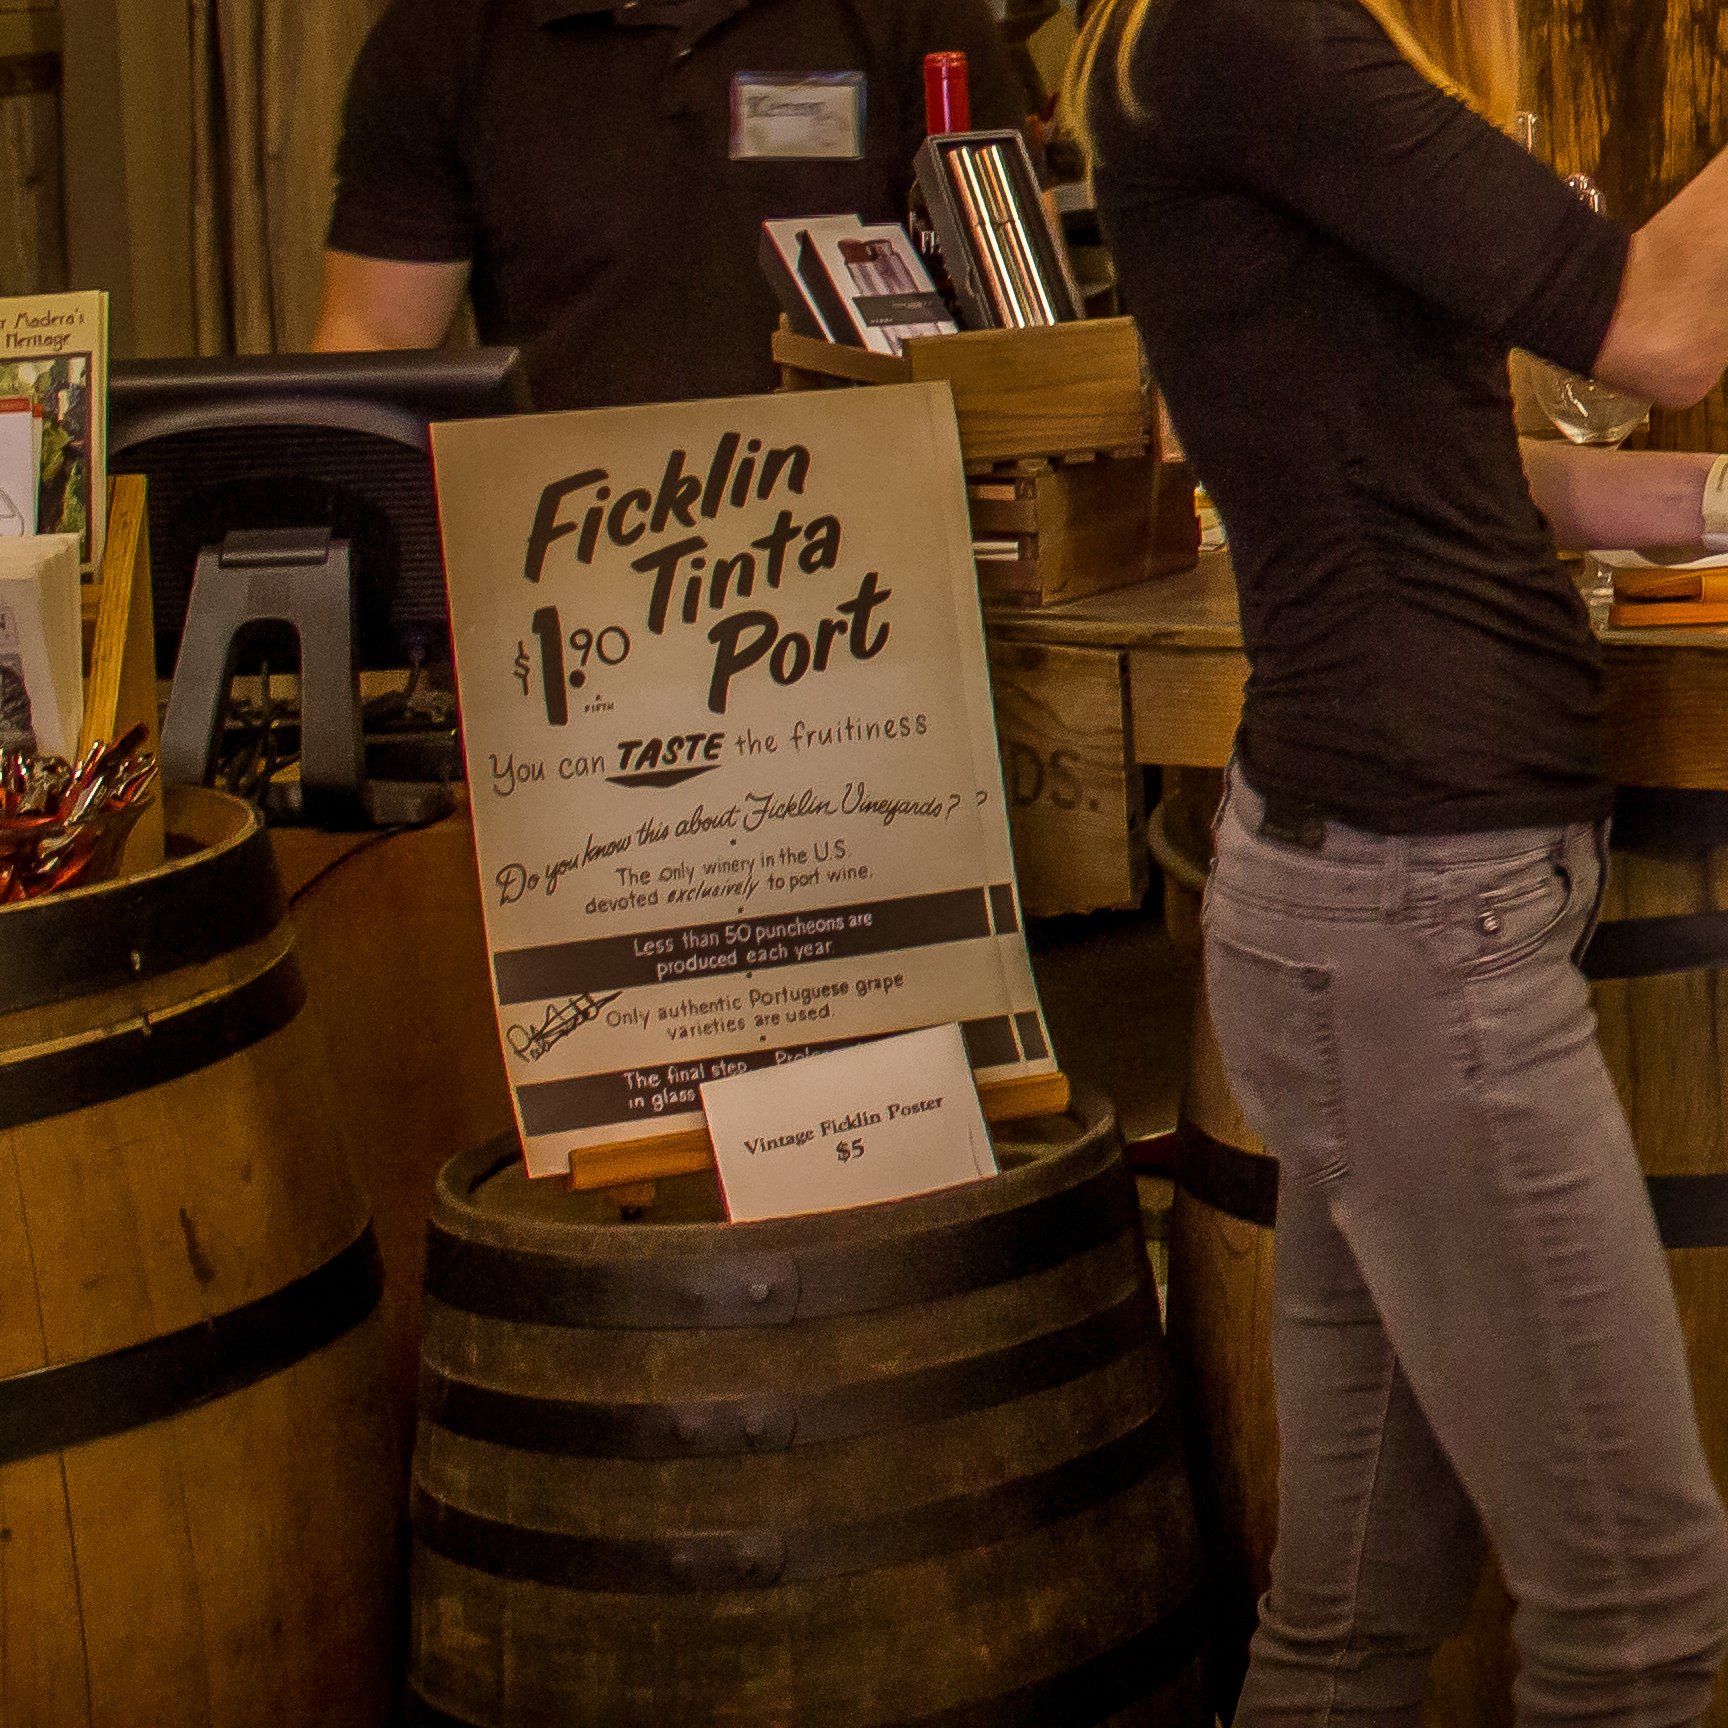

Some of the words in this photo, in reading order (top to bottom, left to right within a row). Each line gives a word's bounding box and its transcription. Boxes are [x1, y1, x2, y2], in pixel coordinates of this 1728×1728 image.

[525, 432, 810, 583] Ficklin
[631, 511, 840, 635] Tinta
[707, 572, 892, 714] Port
[489, 752, 545, 797] You
[559, 752, 605, 779] can
[617, 732, 725, 771] TASTE
[735, 725, 778, 755] the
[790, 712, 928, 750] fruitiness
[496, 863, 540, 907] Do
[545, 854, 580, 896] you
[582, 833, 631, 868] know
[636, 817, 669, 847] this
[675, 804, 740, 838] about
[743, 788, 836, 832] Ficklin
[841, 782, 961, 826] Vineyards?
[615, 867, 651, 887] The
[702, 858, 755, 878] winery
[760, 855, 774, 868] in
[780, 847, 808, 866] the
[585, 890, 659, 915] devoted
[667, 878, 759, 901] exclusively
[768, 874, 785, 890] to
[790, 868, 819, 893] port
[634, 937, 674, 958] Less
[682, 930, 720, 950] than
[724, 924, 751, 944] 50
[755, 916, 845, 946] puncheons
[848, 912, 873, 928] are
[657, 950, 737, 981] produced
[746, 944, 788, 963] each
[606, 1008, 650, 1030] Only
[657, 995, 742, 1021] authentic
[749, 982, 849, 1009] Portuguese
[855, 973, 904, 996] grape
[667, 1018, 746, 1041] varieties
[754, 1013, 780, 1028] are
[623, 1071, 662, 1091] The
[667, 1062, 705, 1085] final
[628, 1099, 645, 1110] in
[652, 1088, 696, 1113] glass
[743, 1129, 815, 1155] Vintage
[818, 1111, 882, 1137] Ficklin
[887, 1097, 944, 1121] Poster
[836, 1138, 865, 1163] $5
